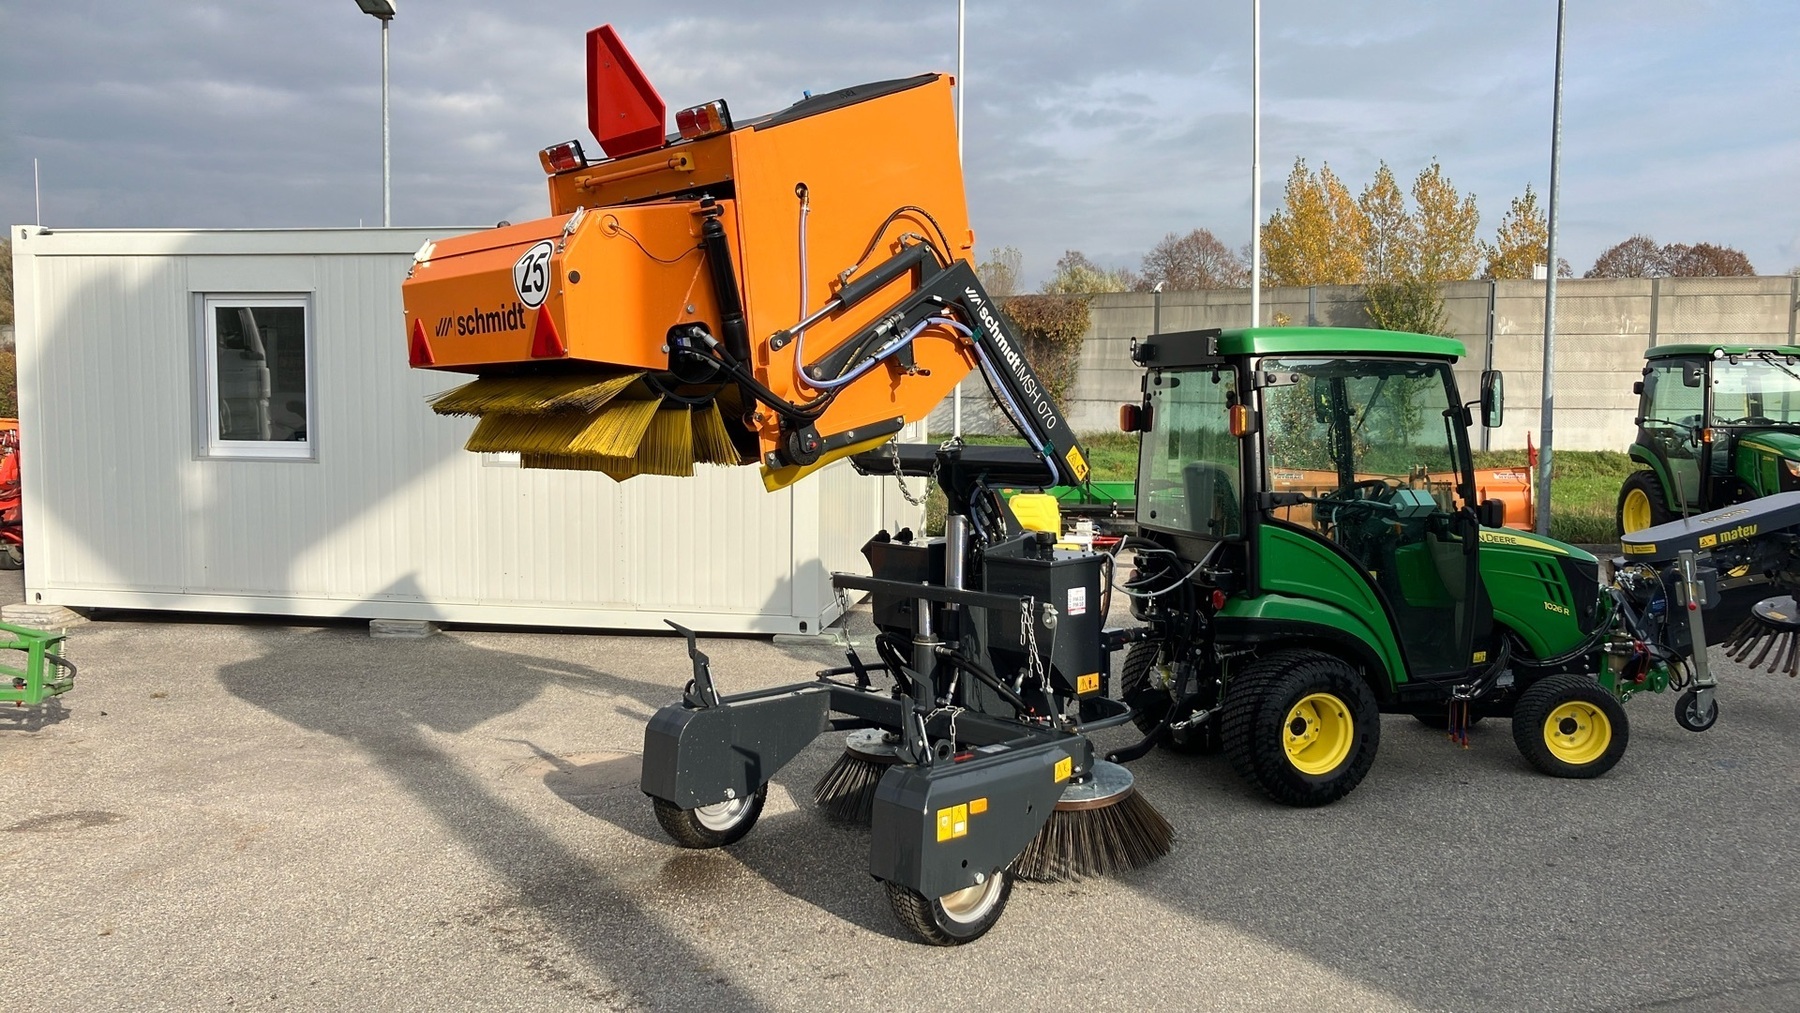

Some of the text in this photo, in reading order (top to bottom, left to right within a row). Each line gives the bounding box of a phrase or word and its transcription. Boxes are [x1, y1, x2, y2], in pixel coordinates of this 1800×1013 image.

[521, 252, 548, 293] 25
[457, 302, 526, 336] schmidt
[979, 307, 1057, 430] schmidt MSH 070
[1486, 533, 1517, 545] DEERE
[1720, 524, 1758, 543] matev
[1543, 601, 1570, 616] 1026 R
